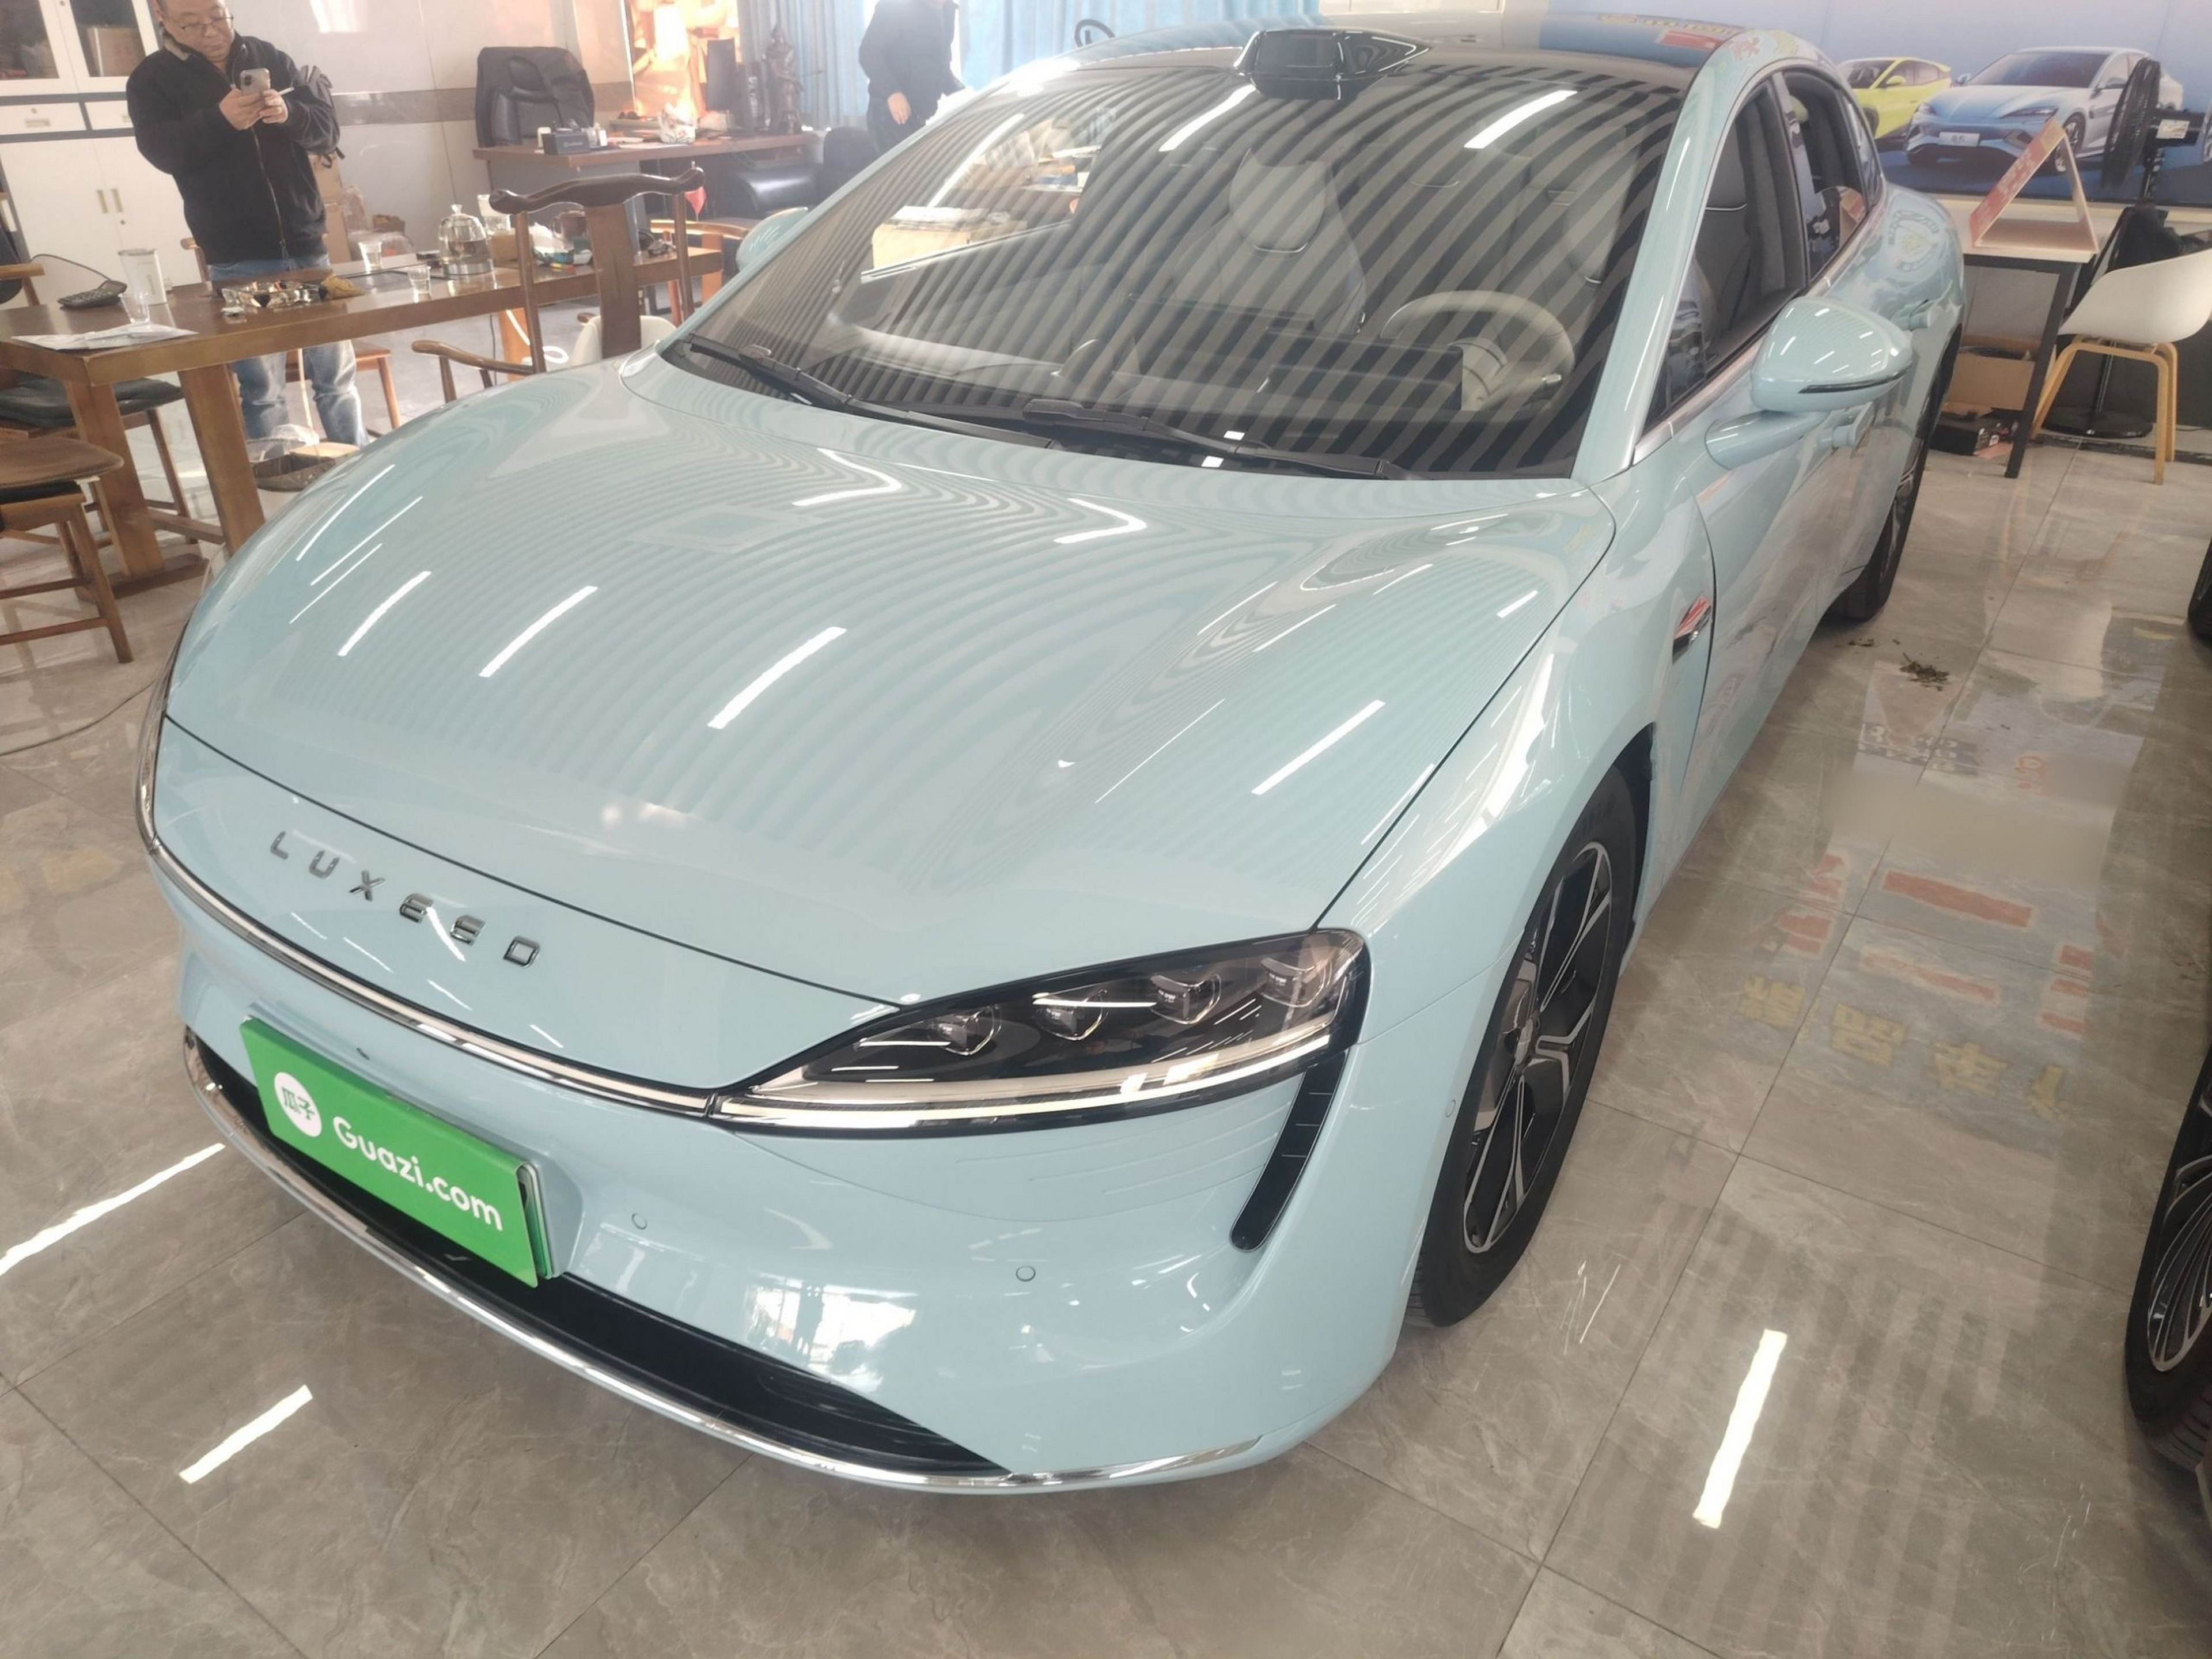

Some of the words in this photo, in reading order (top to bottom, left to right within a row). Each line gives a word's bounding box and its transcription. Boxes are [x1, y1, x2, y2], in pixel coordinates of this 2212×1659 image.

[270, 831, 540, 967] LUXEED
[282, 1086, 315, 1120] 瓜子
[332, 1116, 503, 1232] Guazi.com
